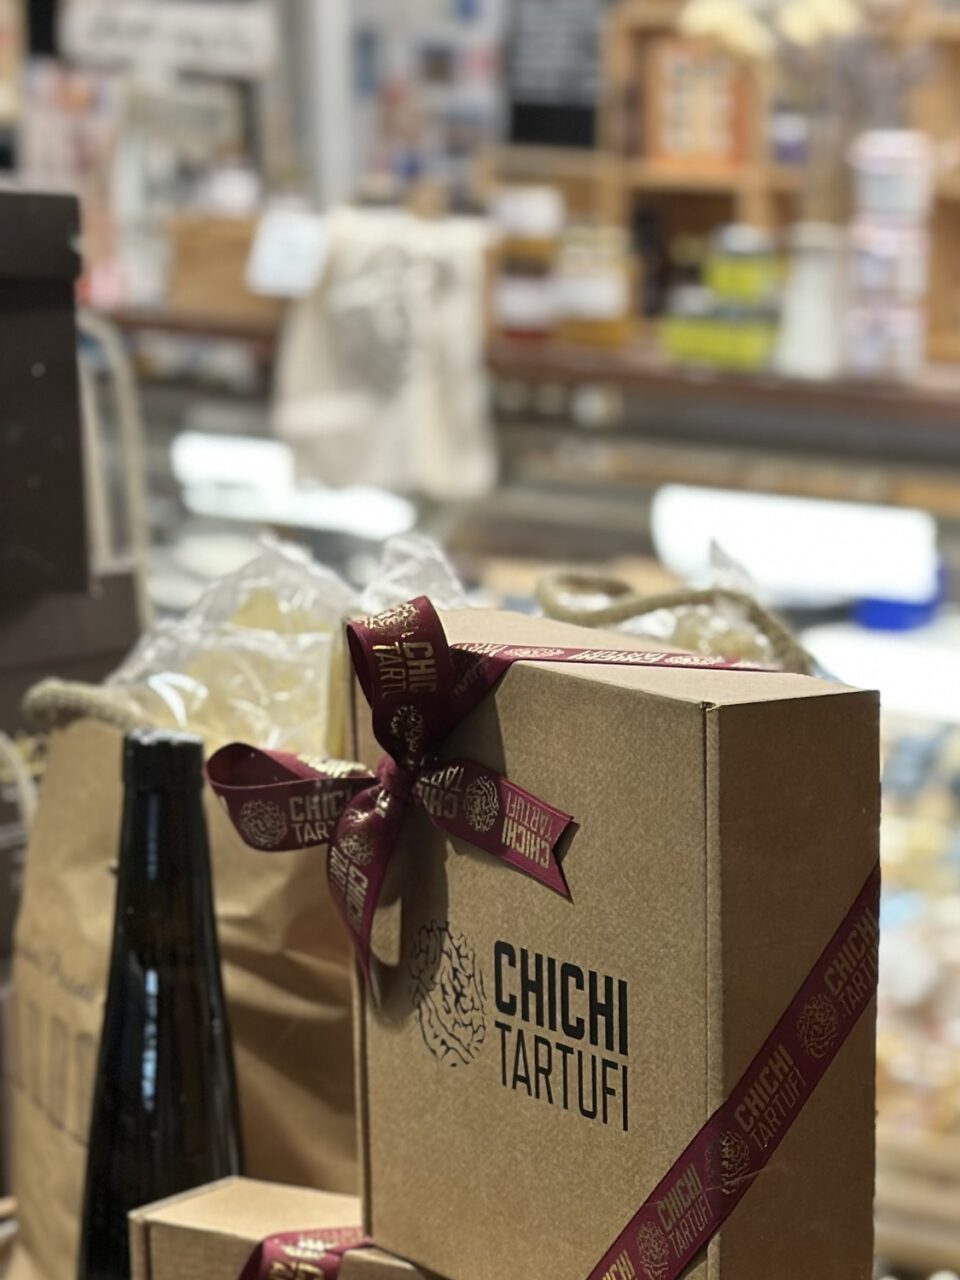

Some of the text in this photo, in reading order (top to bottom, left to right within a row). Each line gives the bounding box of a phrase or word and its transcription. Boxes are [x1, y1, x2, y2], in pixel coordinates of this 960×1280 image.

[501, 818, 551, 870] CHICHI
[505, 791, 553, 842] TARTUFI
[494, 939, 629, 1057] CHICHI
[494, 1019, 629, 1132] TARTUFI
[733, 1043, 795, 1134] CHICHI
[750, 1066, 807, 1151] TARTUFI
[657, 1162, 703, 1233] CHICHI
[668, 1192, 715, 1259] TARTUFI
